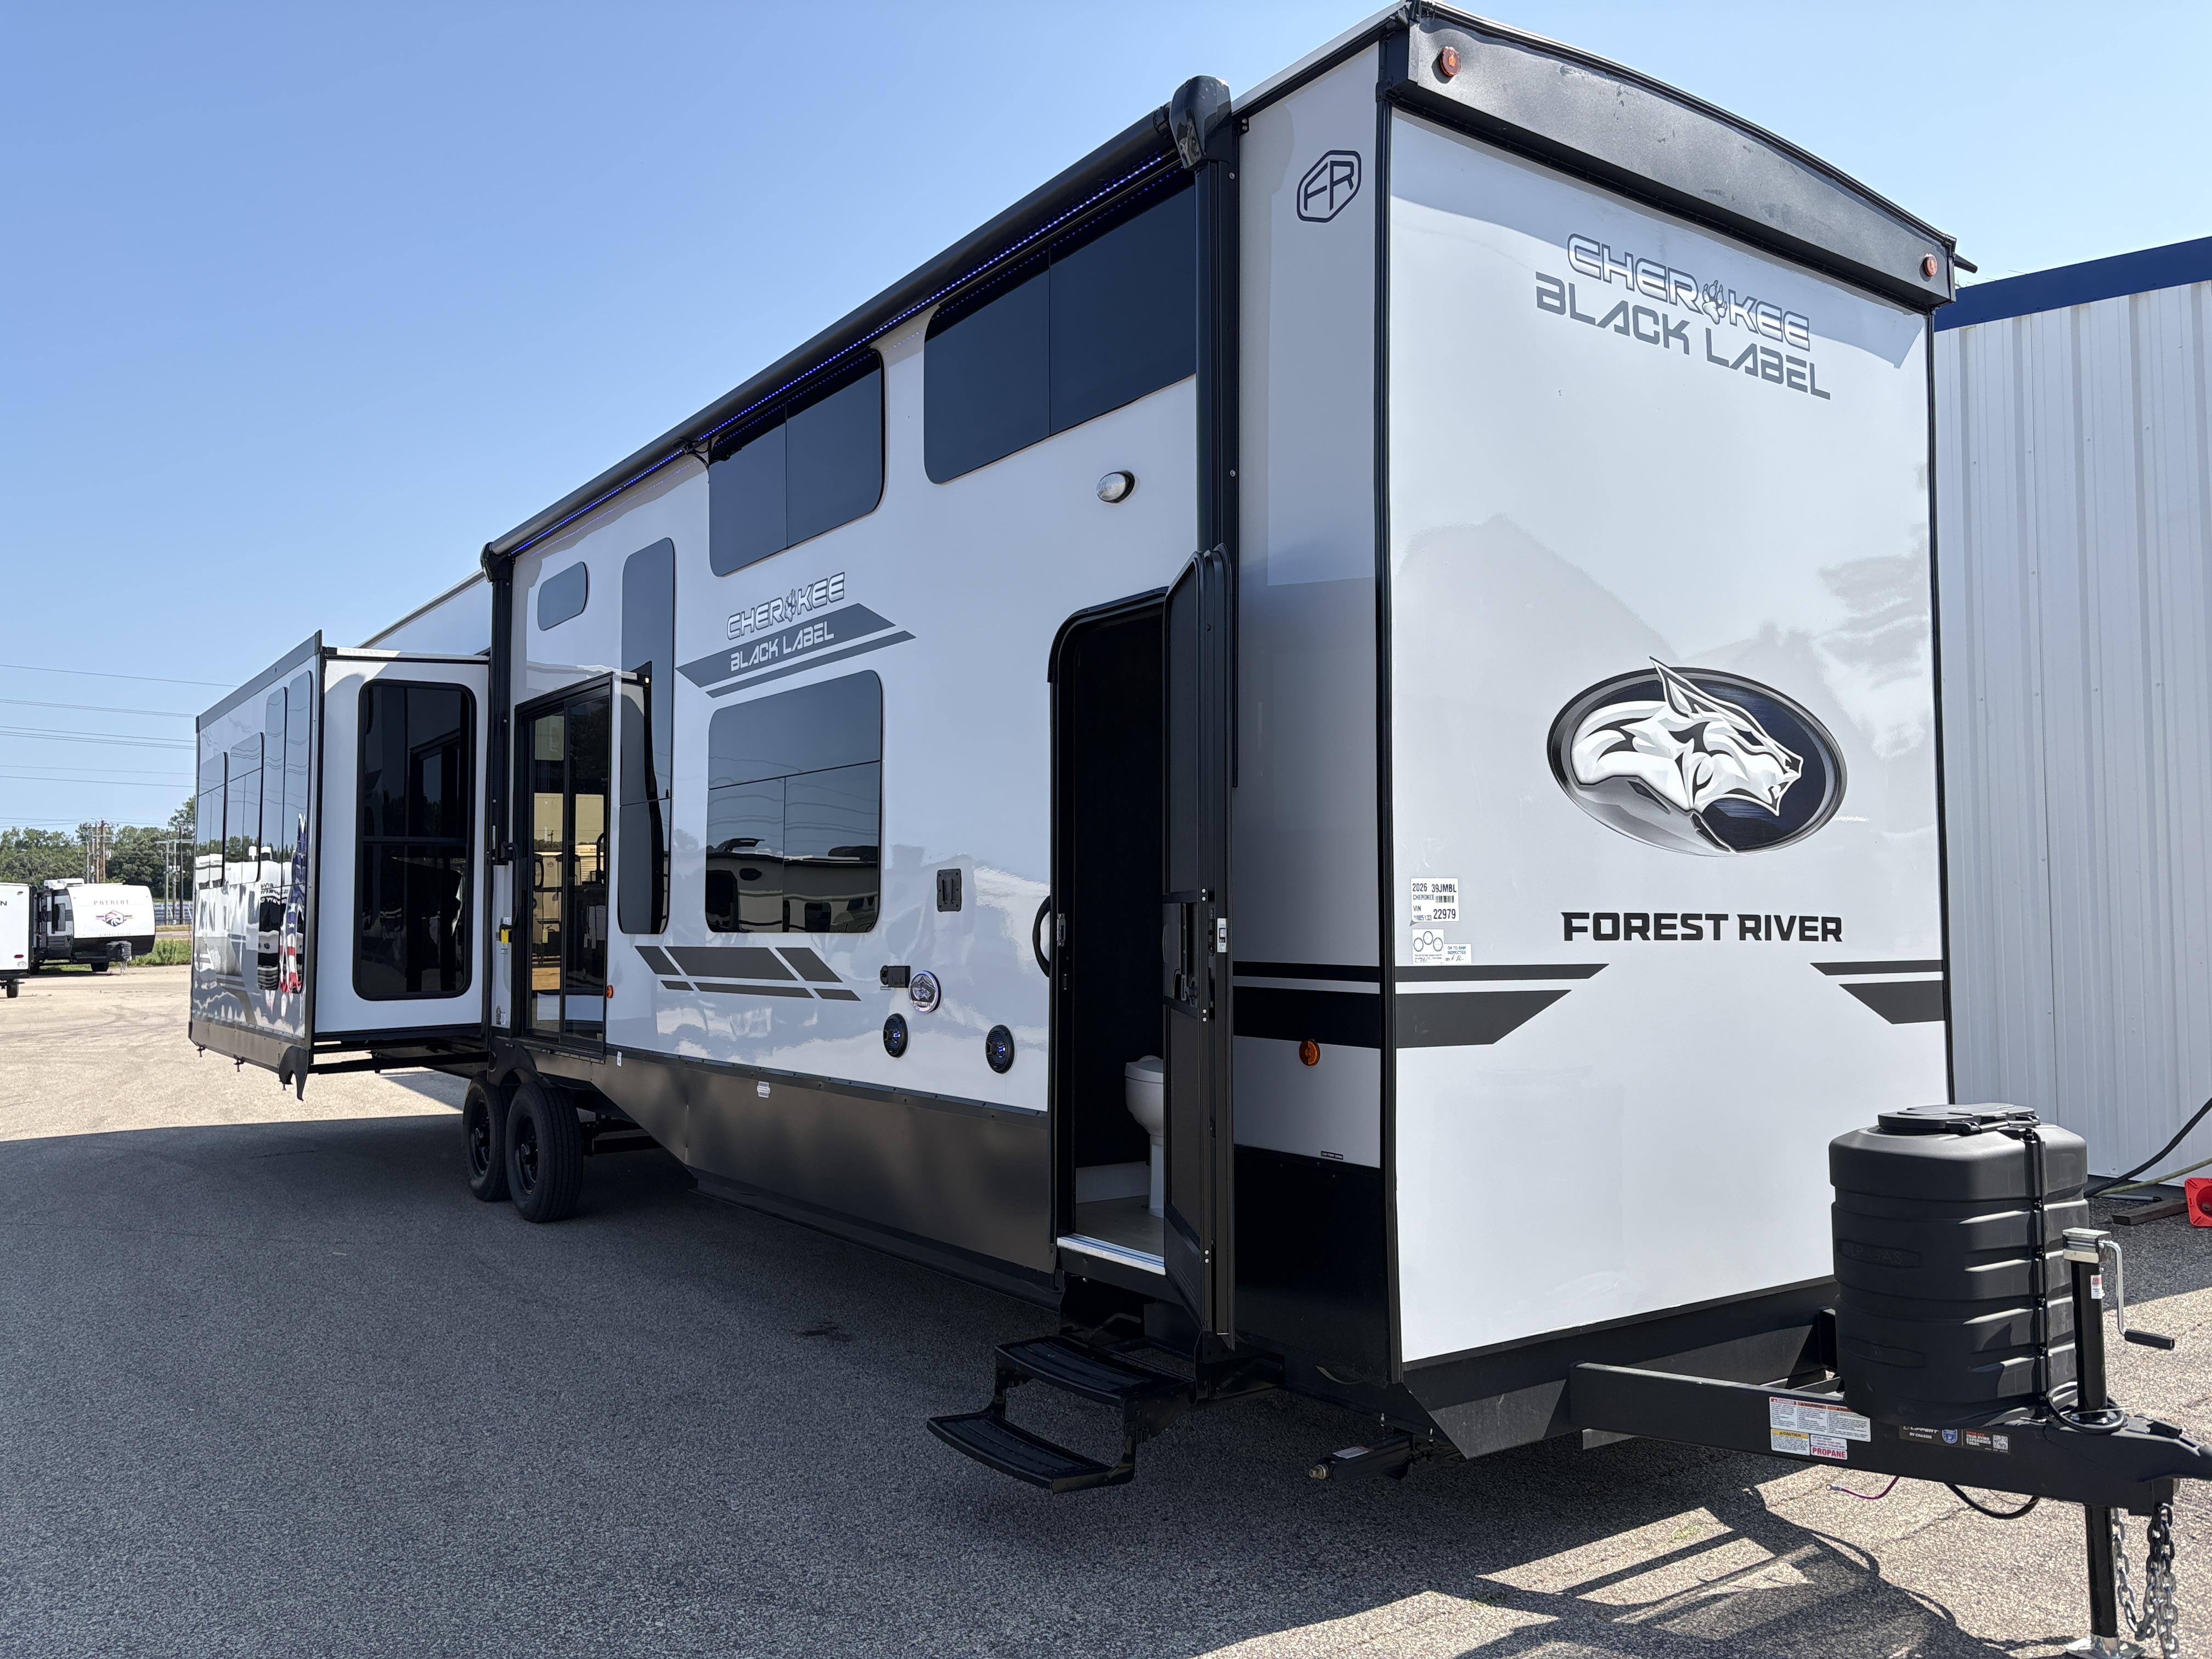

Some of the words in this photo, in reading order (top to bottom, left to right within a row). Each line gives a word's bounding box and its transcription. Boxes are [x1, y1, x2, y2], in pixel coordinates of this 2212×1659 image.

[1567, 233, 1810, 352] CHEROKEE
[1535, 270, 1690, 356] BLACK
[1705, 327, 1831, 400] LABEL
[726, 571, 845, 641] CHEROKEE
[730, 637, 779, 672] BLACK
[782, 620, 835, 654] LABEL
[1412, 883, 1427, 892] 2026
[1431, 883, 1457, 893] 39JMBL
[1433, 909, 1456, 919] 22979
[1560, 912, 1729, 941] FOREST
[1736, 913, 1843, 943] RIVER
[1849, 1242, 1864, 1257] LP
[1867, 1246, 1902, 1265] GAS
[1812, 1447, 1846, 1459] PROPANE
